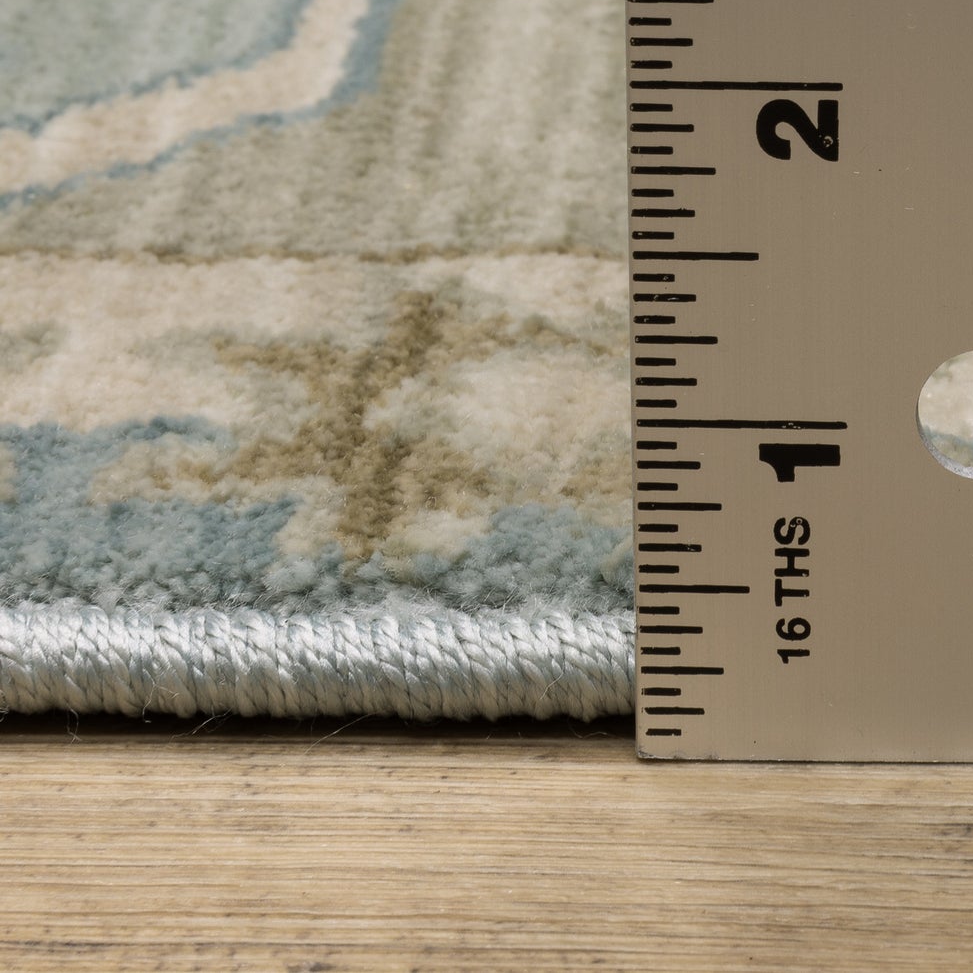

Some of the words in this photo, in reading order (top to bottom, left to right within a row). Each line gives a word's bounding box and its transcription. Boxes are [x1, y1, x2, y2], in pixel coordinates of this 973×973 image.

[756, 99, 839, 161] 2
[759, 443, 840, 483] 1
[773, 516, 811, 607] THS
[776, 618, 811, 664] 16
